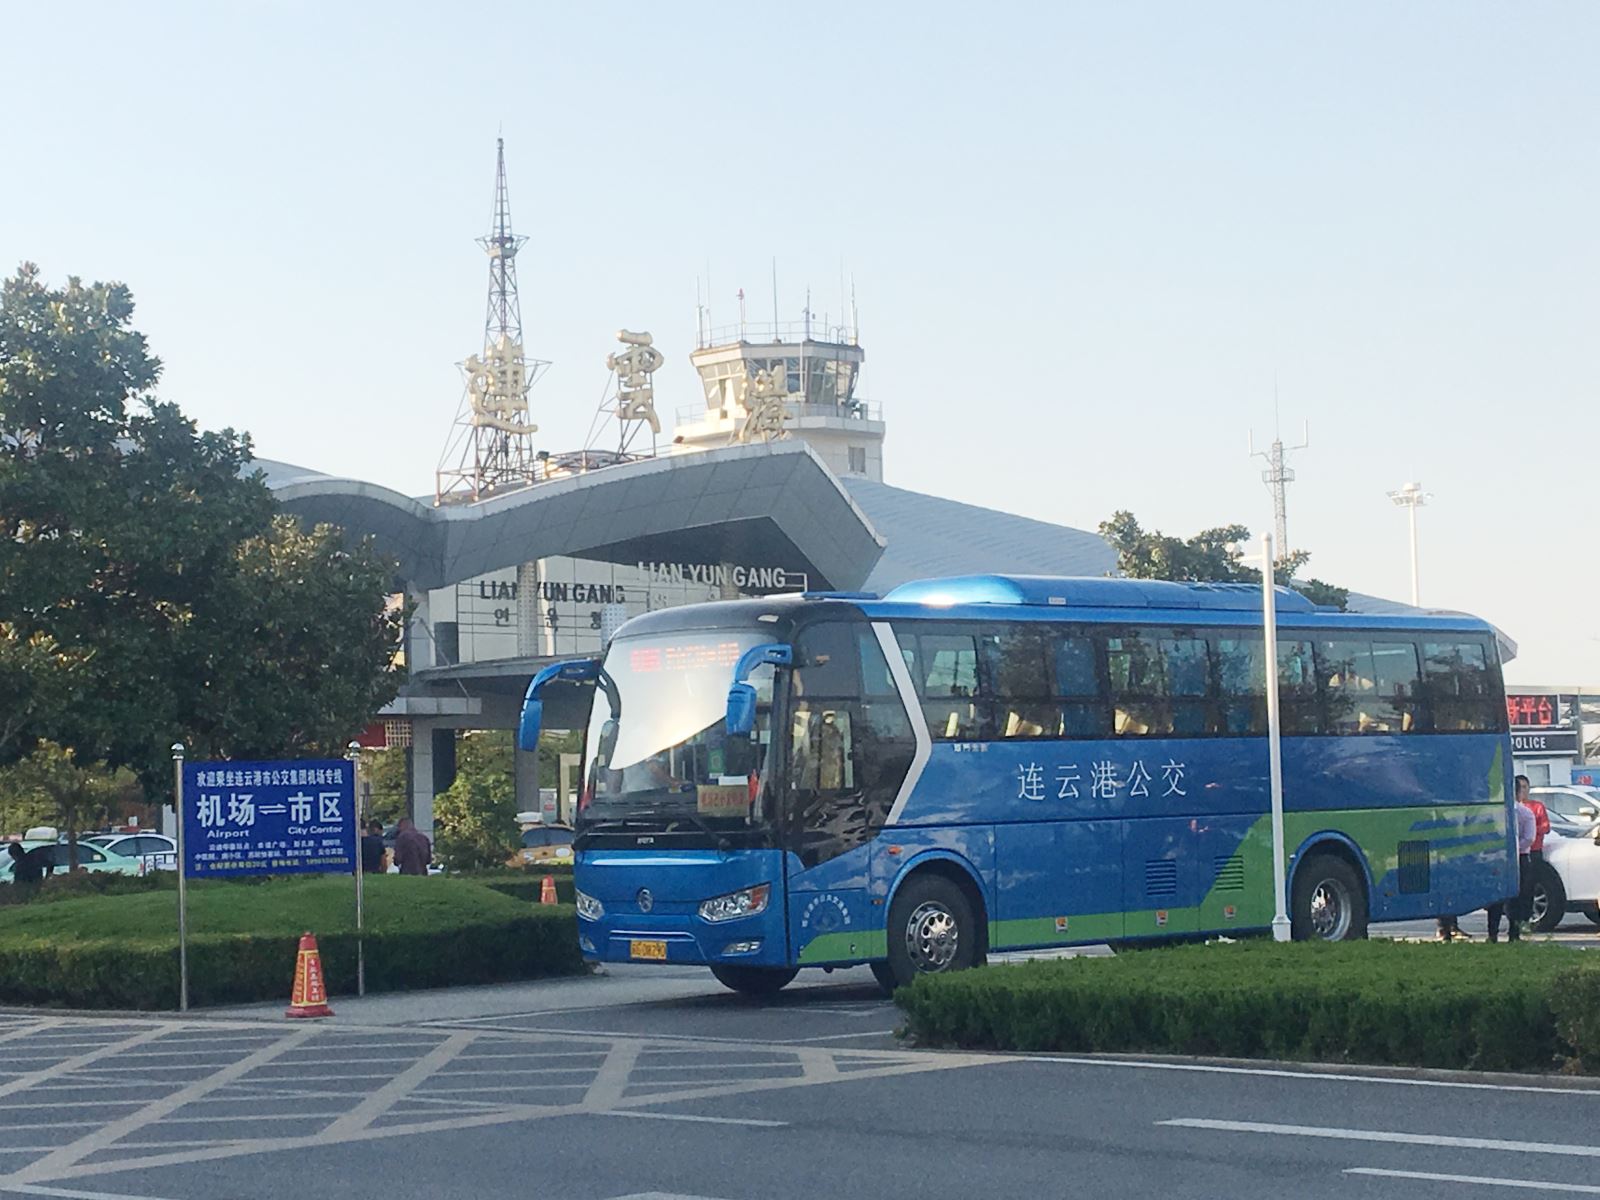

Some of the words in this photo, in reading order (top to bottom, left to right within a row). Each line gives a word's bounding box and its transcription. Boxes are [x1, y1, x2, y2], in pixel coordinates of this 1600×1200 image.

[638, 562, 683, 583] LIAN
[688, 564, 728, 585] YUN
[733, 566, 786, 588] GANG
[1017, 758, 1187, 801] 连云港公交
[196, 793, 255, 828] 机场
[287, 792, 344, 825] 市区
[207, 829, 250, 839] Airport
[287, 826, 308, 836] City
[309, 825, 344, 834] Center
